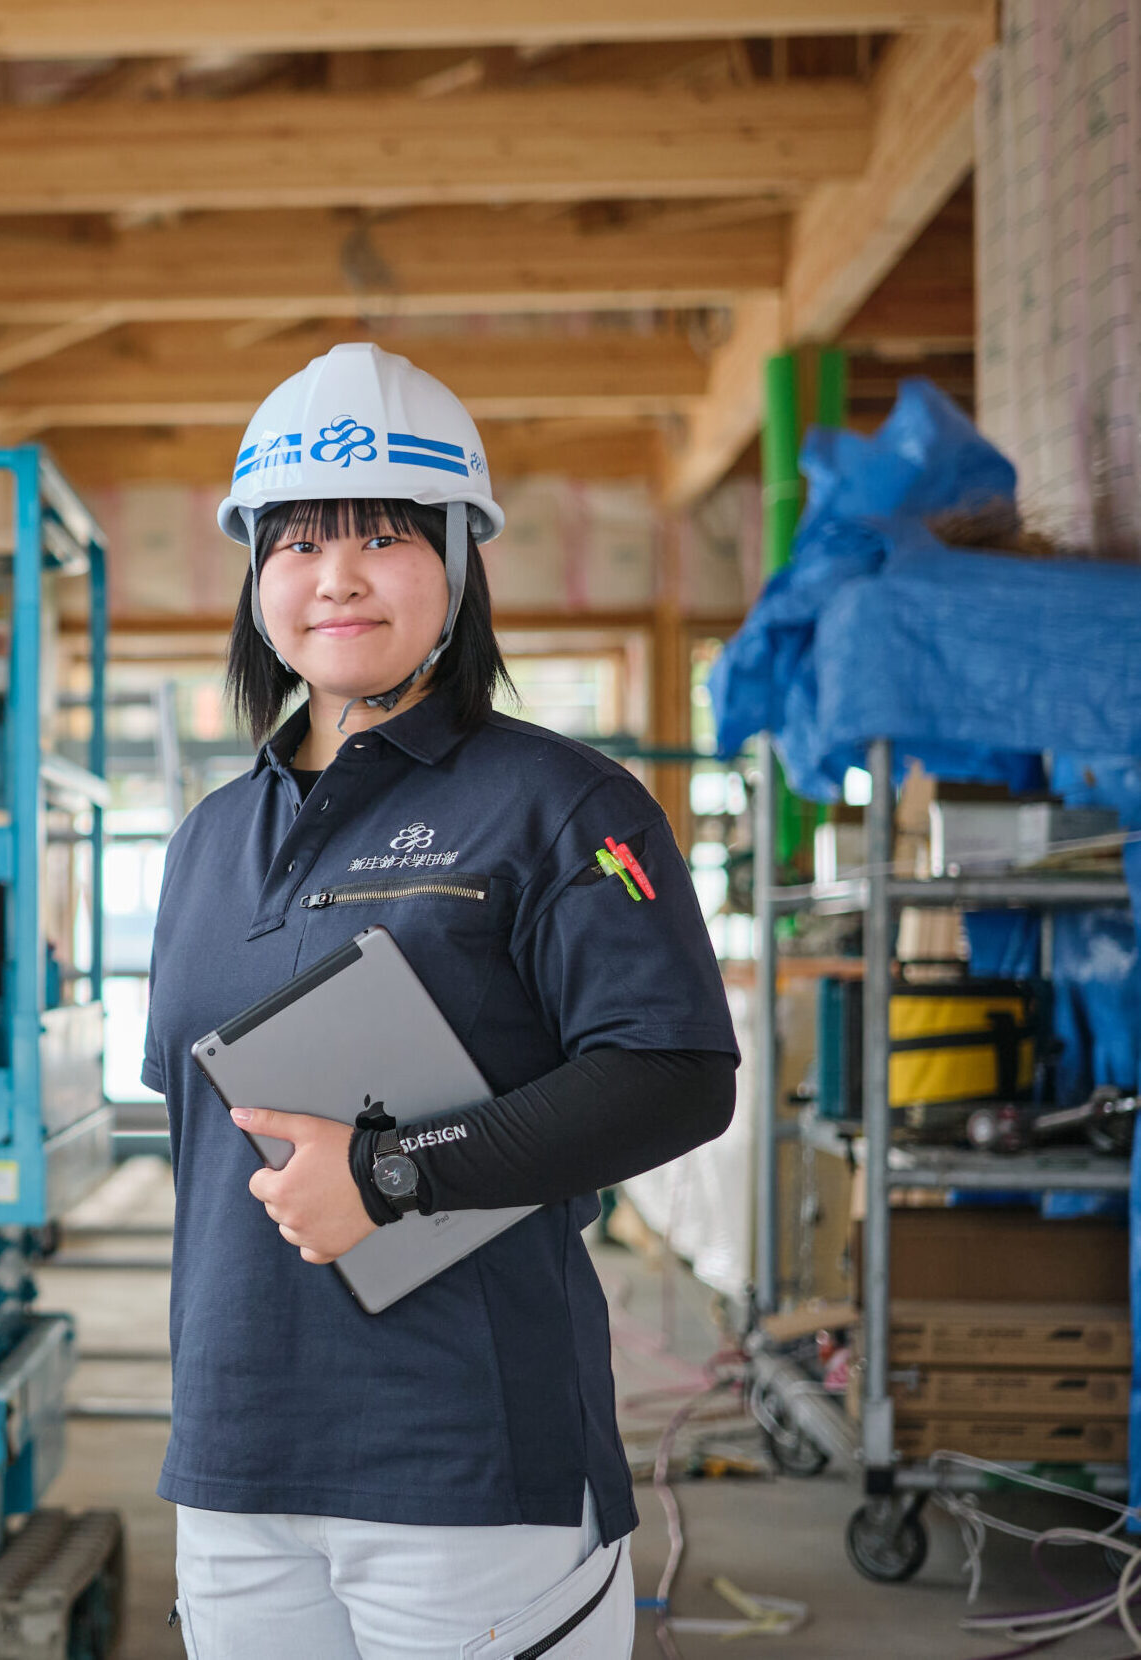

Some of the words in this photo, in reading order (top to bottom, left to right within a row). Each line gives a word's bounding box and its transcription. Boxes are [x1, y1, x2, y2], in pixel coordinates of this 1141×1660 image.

[348, 850, 459, 872] 新庄鈴木柴田組
[434, 1214, 450, 1226] iPad
